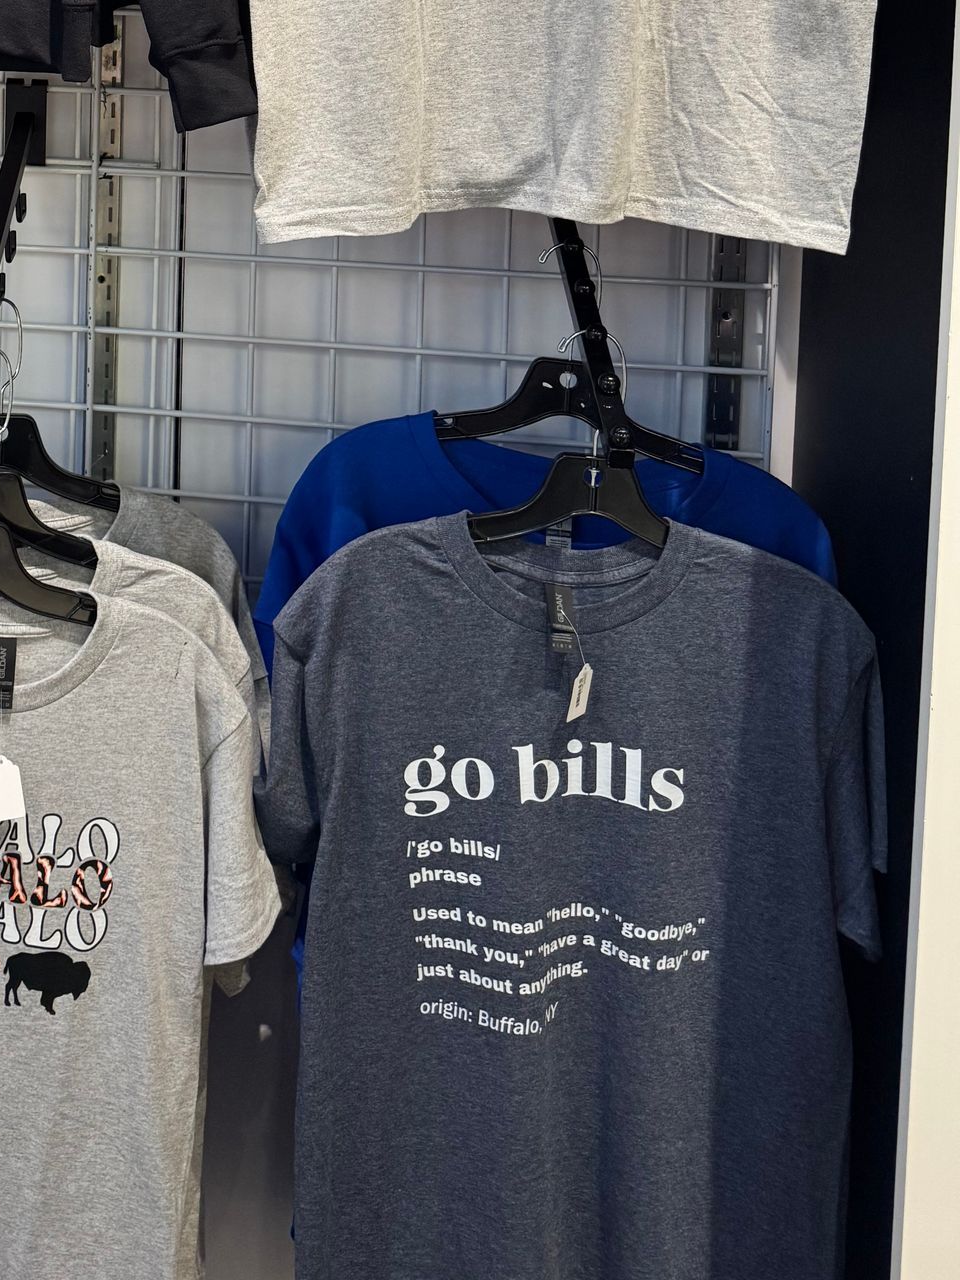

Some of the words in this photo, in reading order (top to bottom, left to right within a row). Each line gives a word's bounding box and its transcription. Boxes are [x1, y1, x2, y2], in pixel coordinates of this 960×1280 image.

[0, 646, 7, 679] GILDAN
[403, 744, 495, 817] go
[511, 738, 685, 812] bills
[408, 867, 482, 888] phrase
[412, 907, 462, 922] Used
[466, 911, 487, 928] to
[492, 918, 544, 936] mean
[415, 934, 479, 956] "thank
[483, 947, 533, 968] you,"
[582, 934, 595, 947] a
[600, 937, 651, 970] great
[691, 949, 710, 962] or
[416, 963, 454, 981] just
[459, 968, 513, 995] about
[519, 961, 588, 996] anything.
[420, 999, 473, 1023] origin:
[477, 1008, 543, 1036] Buffalo,
